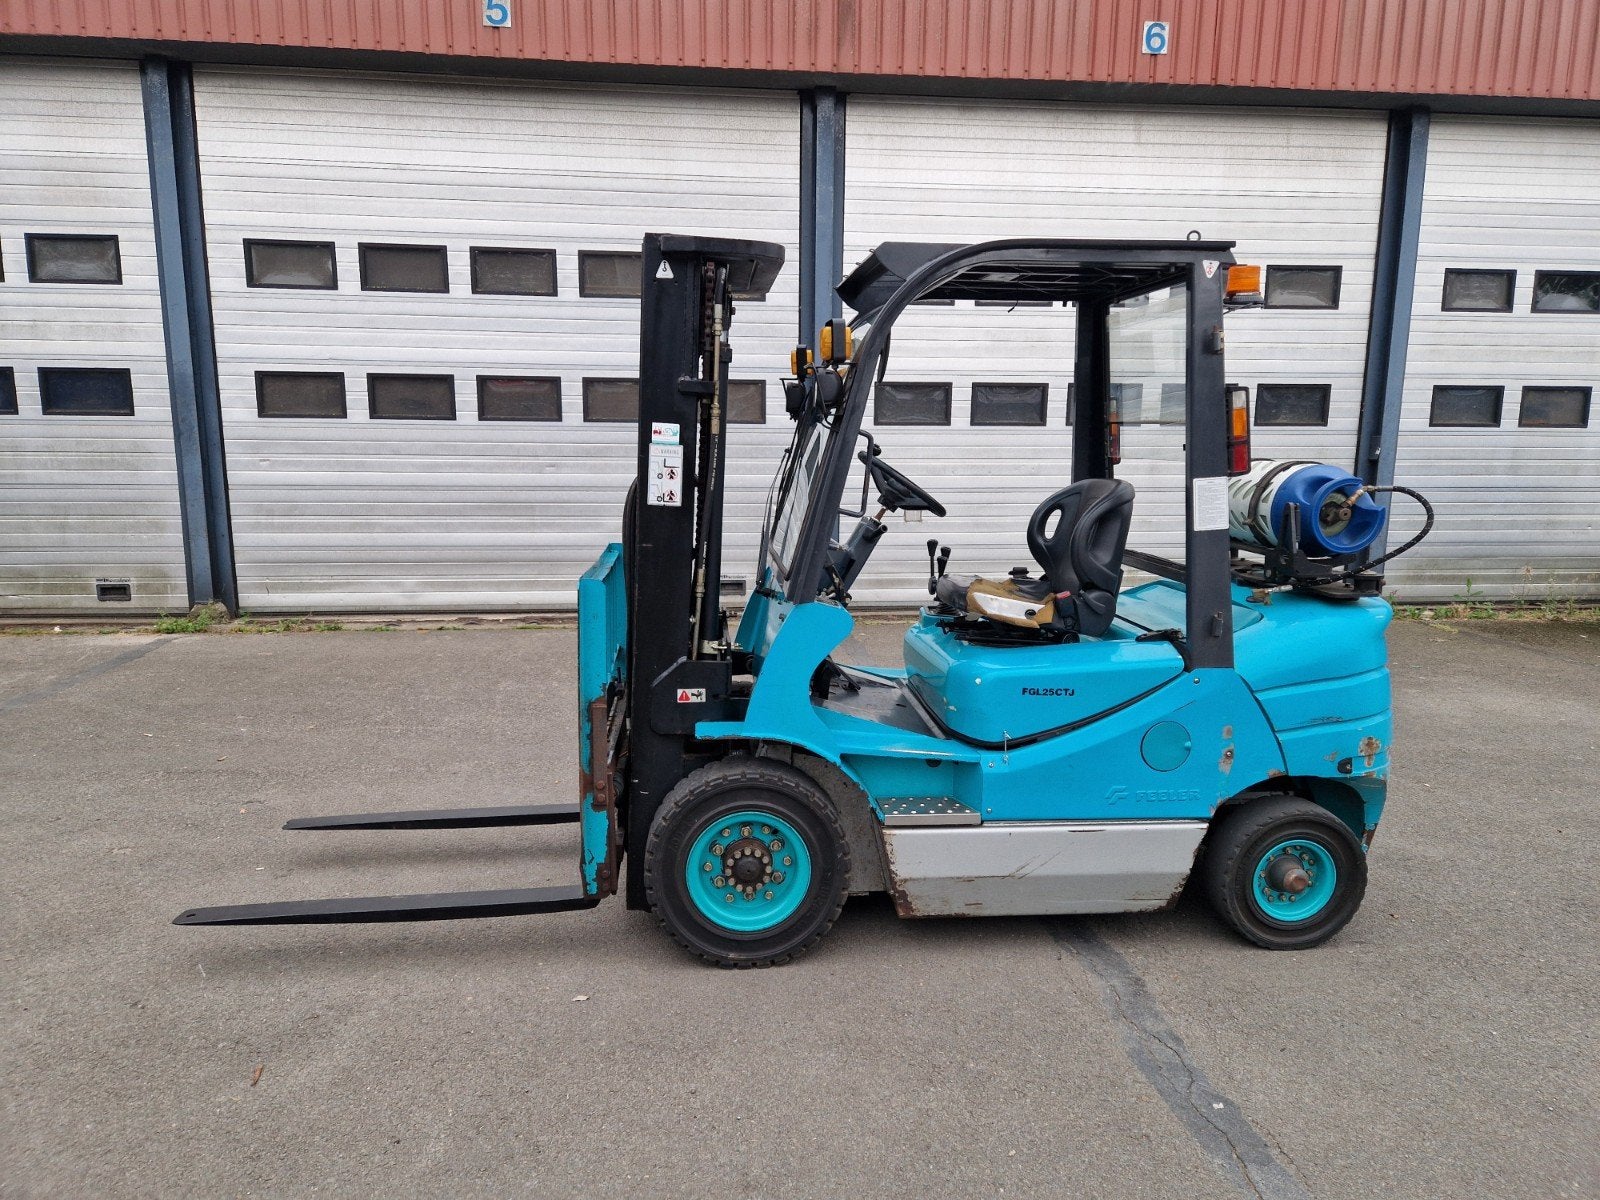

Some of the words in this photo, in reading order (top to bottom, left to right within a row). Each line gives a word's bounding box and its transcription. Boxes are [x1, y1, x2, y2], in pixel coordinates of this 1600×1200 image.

[486, 0, 508, 25] 5
[1145, 22, 1166, 53] 6
[1022, 687, 1075, 697] FGL25CTJ
[1136, 789, 1201, 802] FEELER
